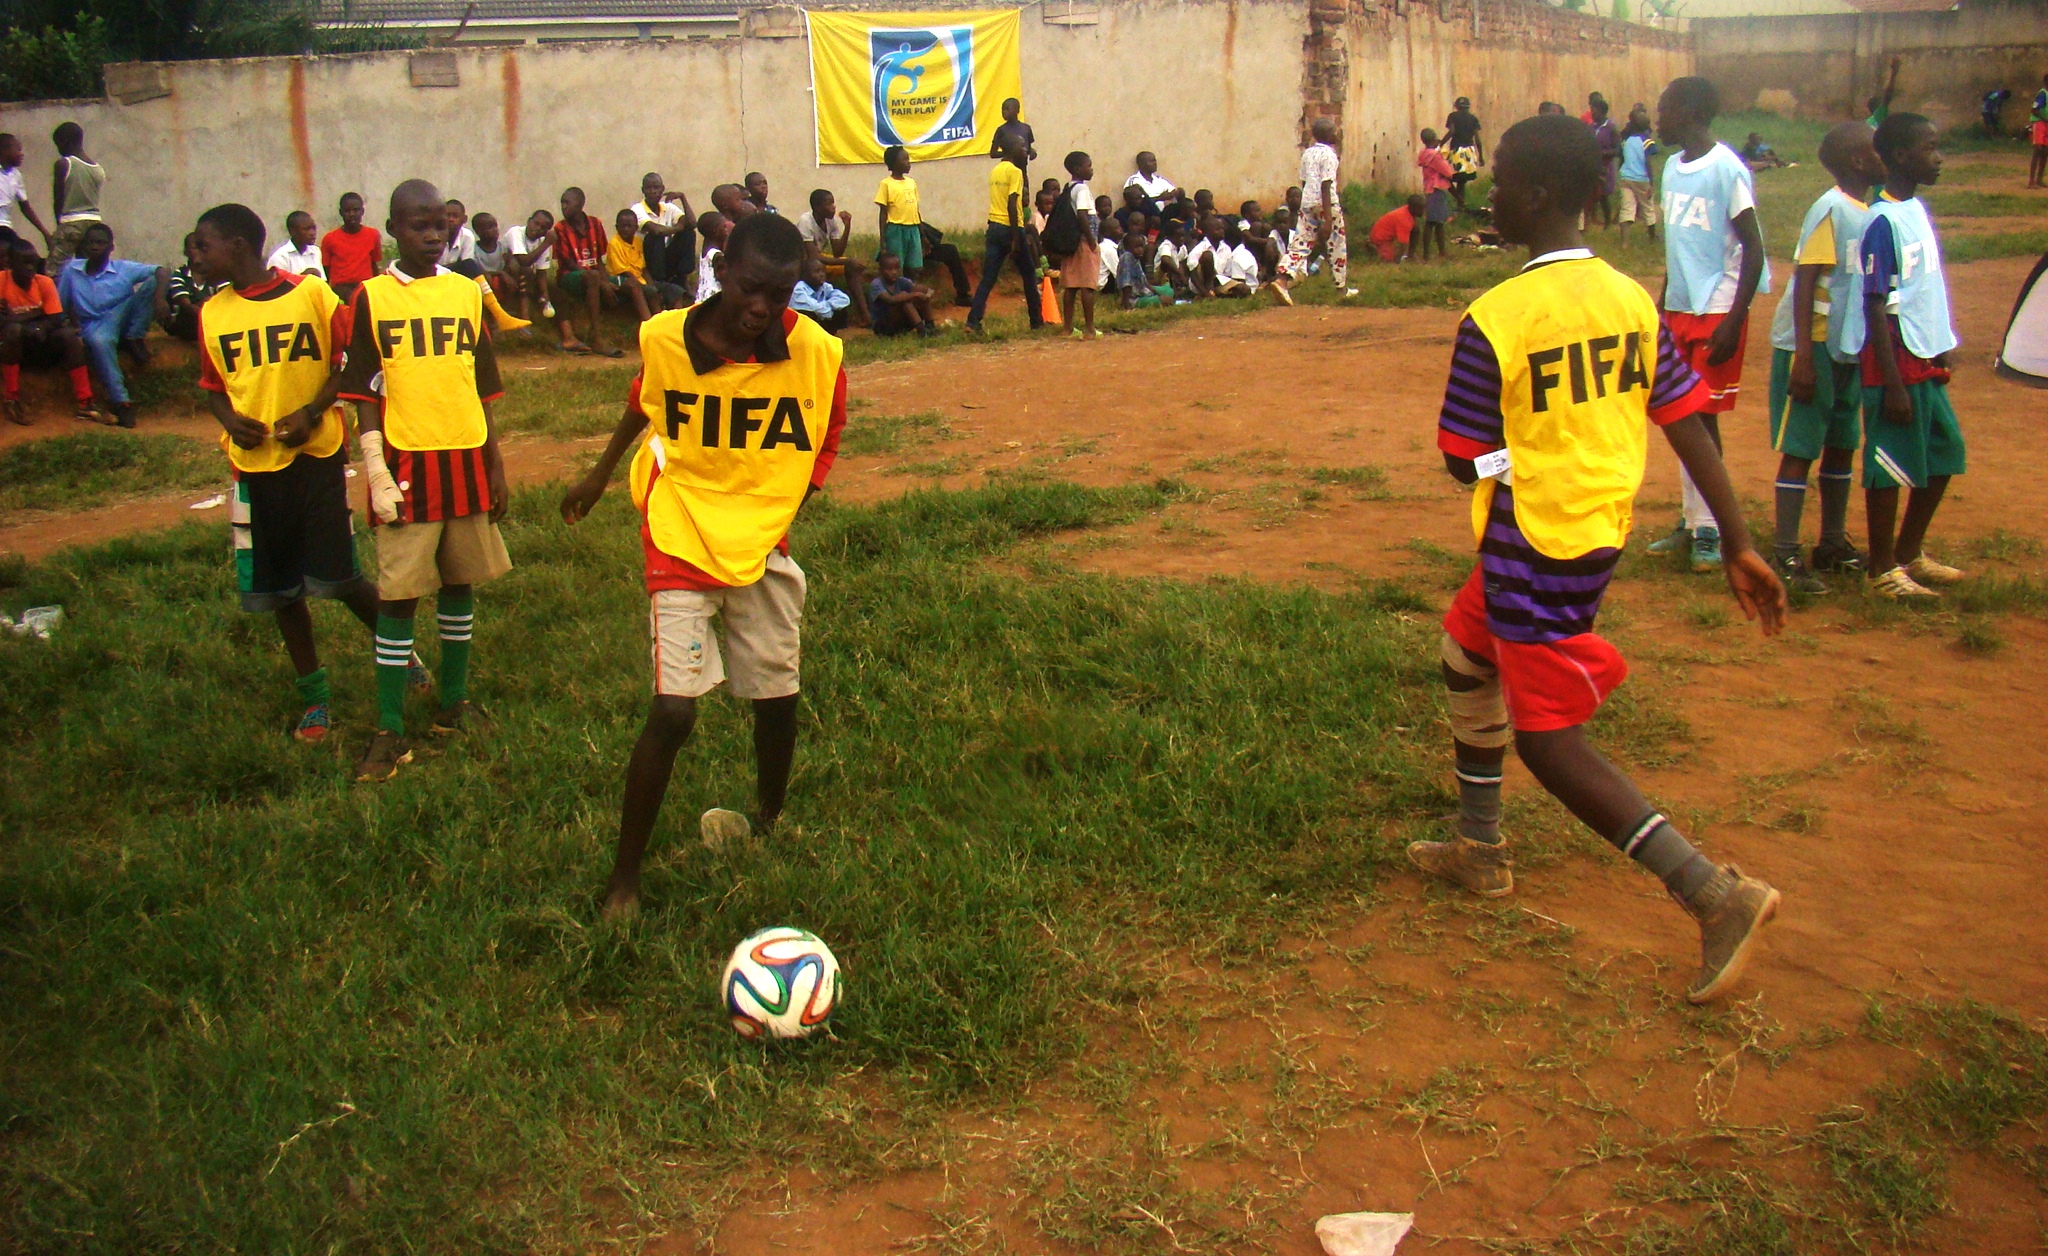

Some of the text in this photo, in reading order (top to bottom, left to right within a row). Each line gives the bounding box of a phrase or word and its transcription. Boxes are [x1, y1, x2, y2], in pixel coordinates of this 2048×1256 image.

[892, 96, 948, 107] MY GAME IS
[914, 106, 936, 114] PLAY
[942, 126, 972, 140] FIFA
[377, 317, 476, 358] FIFA
[219, 323, 322, 373] FIFA
